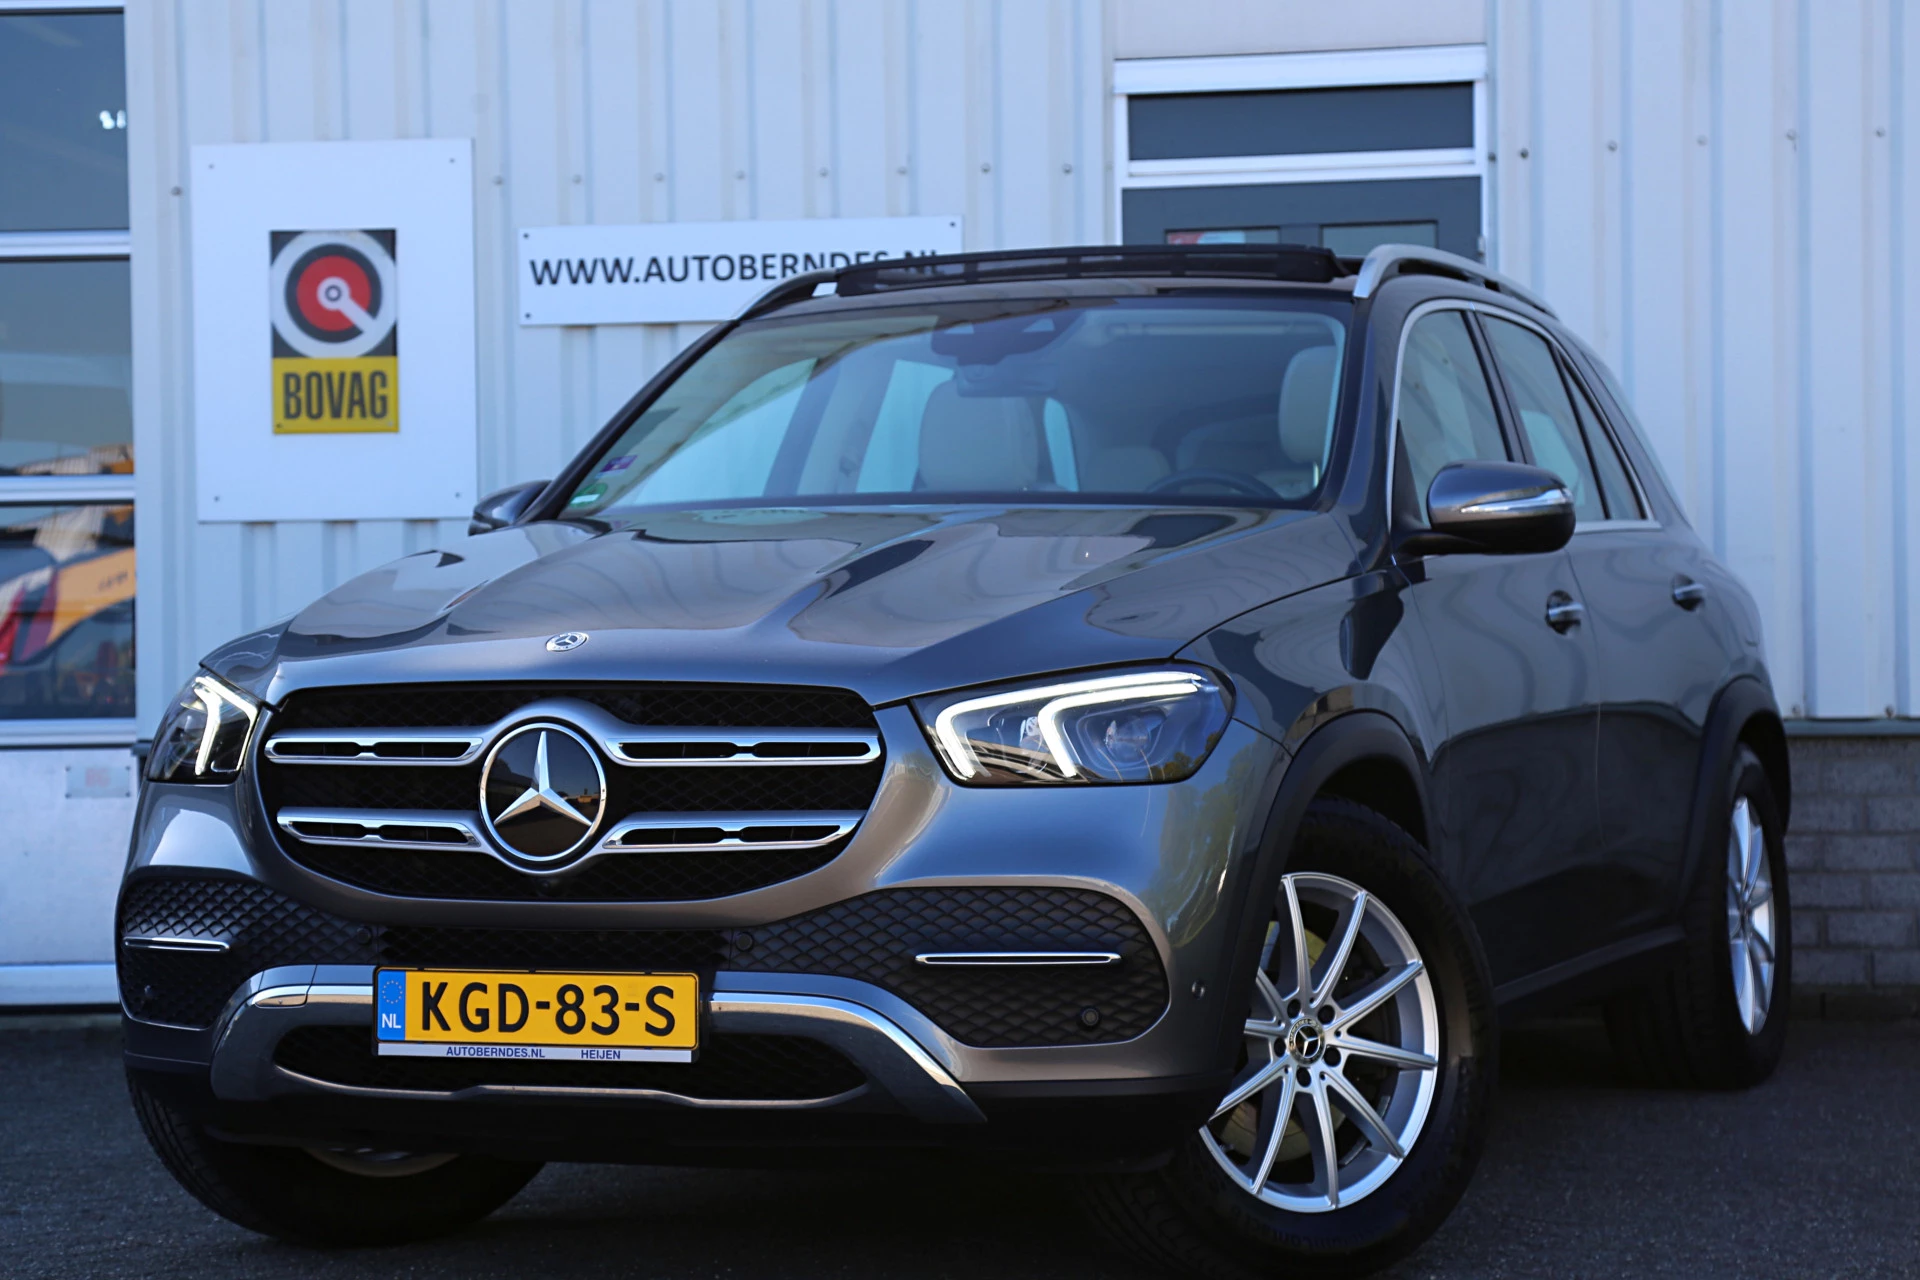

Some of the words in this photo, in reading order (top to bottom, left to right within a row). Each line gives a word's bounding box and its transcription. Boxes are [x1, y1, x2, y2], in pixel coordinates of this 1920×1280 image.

[283, 370, 388, 421] BOVAG
[381, 1013, 402, 1029] NL
[421, 981, 676, 1037] KGD-83-S
[446, 1046, 546, 1059] AUTOBERNDES.NL
[580, 1049, 621, 1060] HEIJEN
